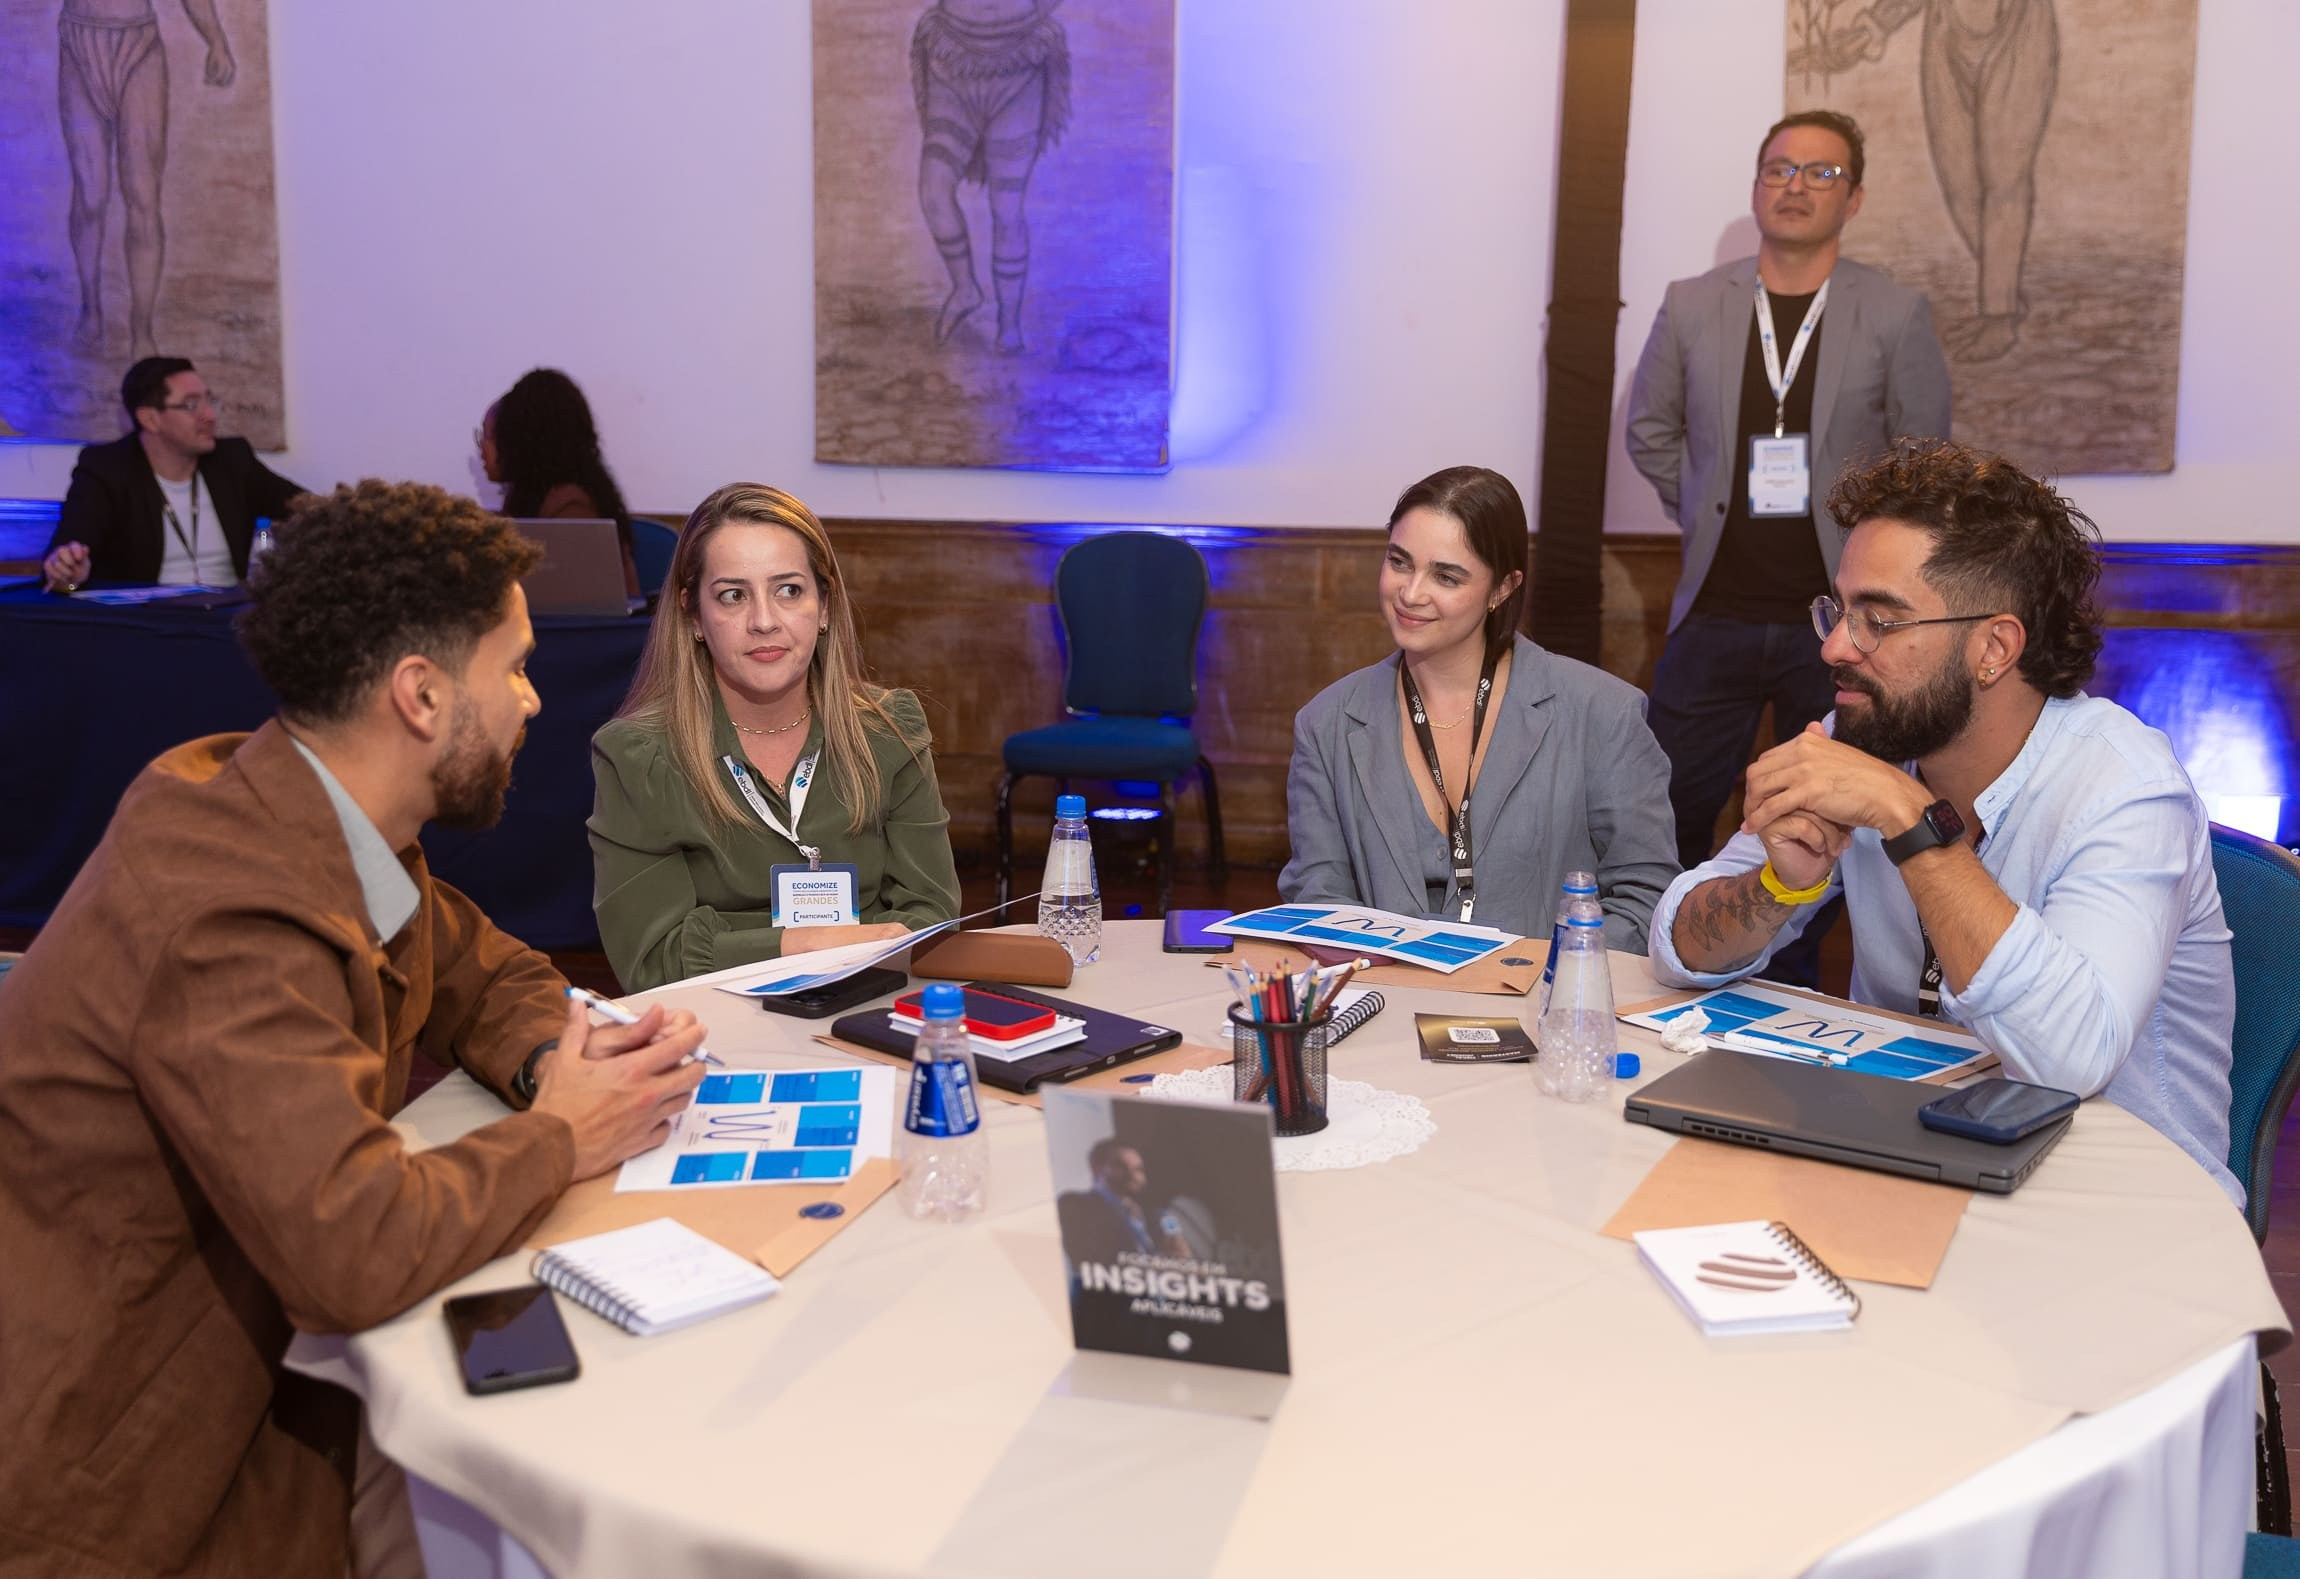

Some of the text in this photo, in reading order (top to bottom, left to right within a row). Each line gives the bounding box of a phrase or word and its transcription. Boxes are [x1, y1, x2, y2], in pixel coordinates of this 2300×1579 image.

[737, 777, 752, 795] ebdi
[793, 897, 838, 905] GRANDES
[1080, 1261, 1270, 1311] INSIGHTS
